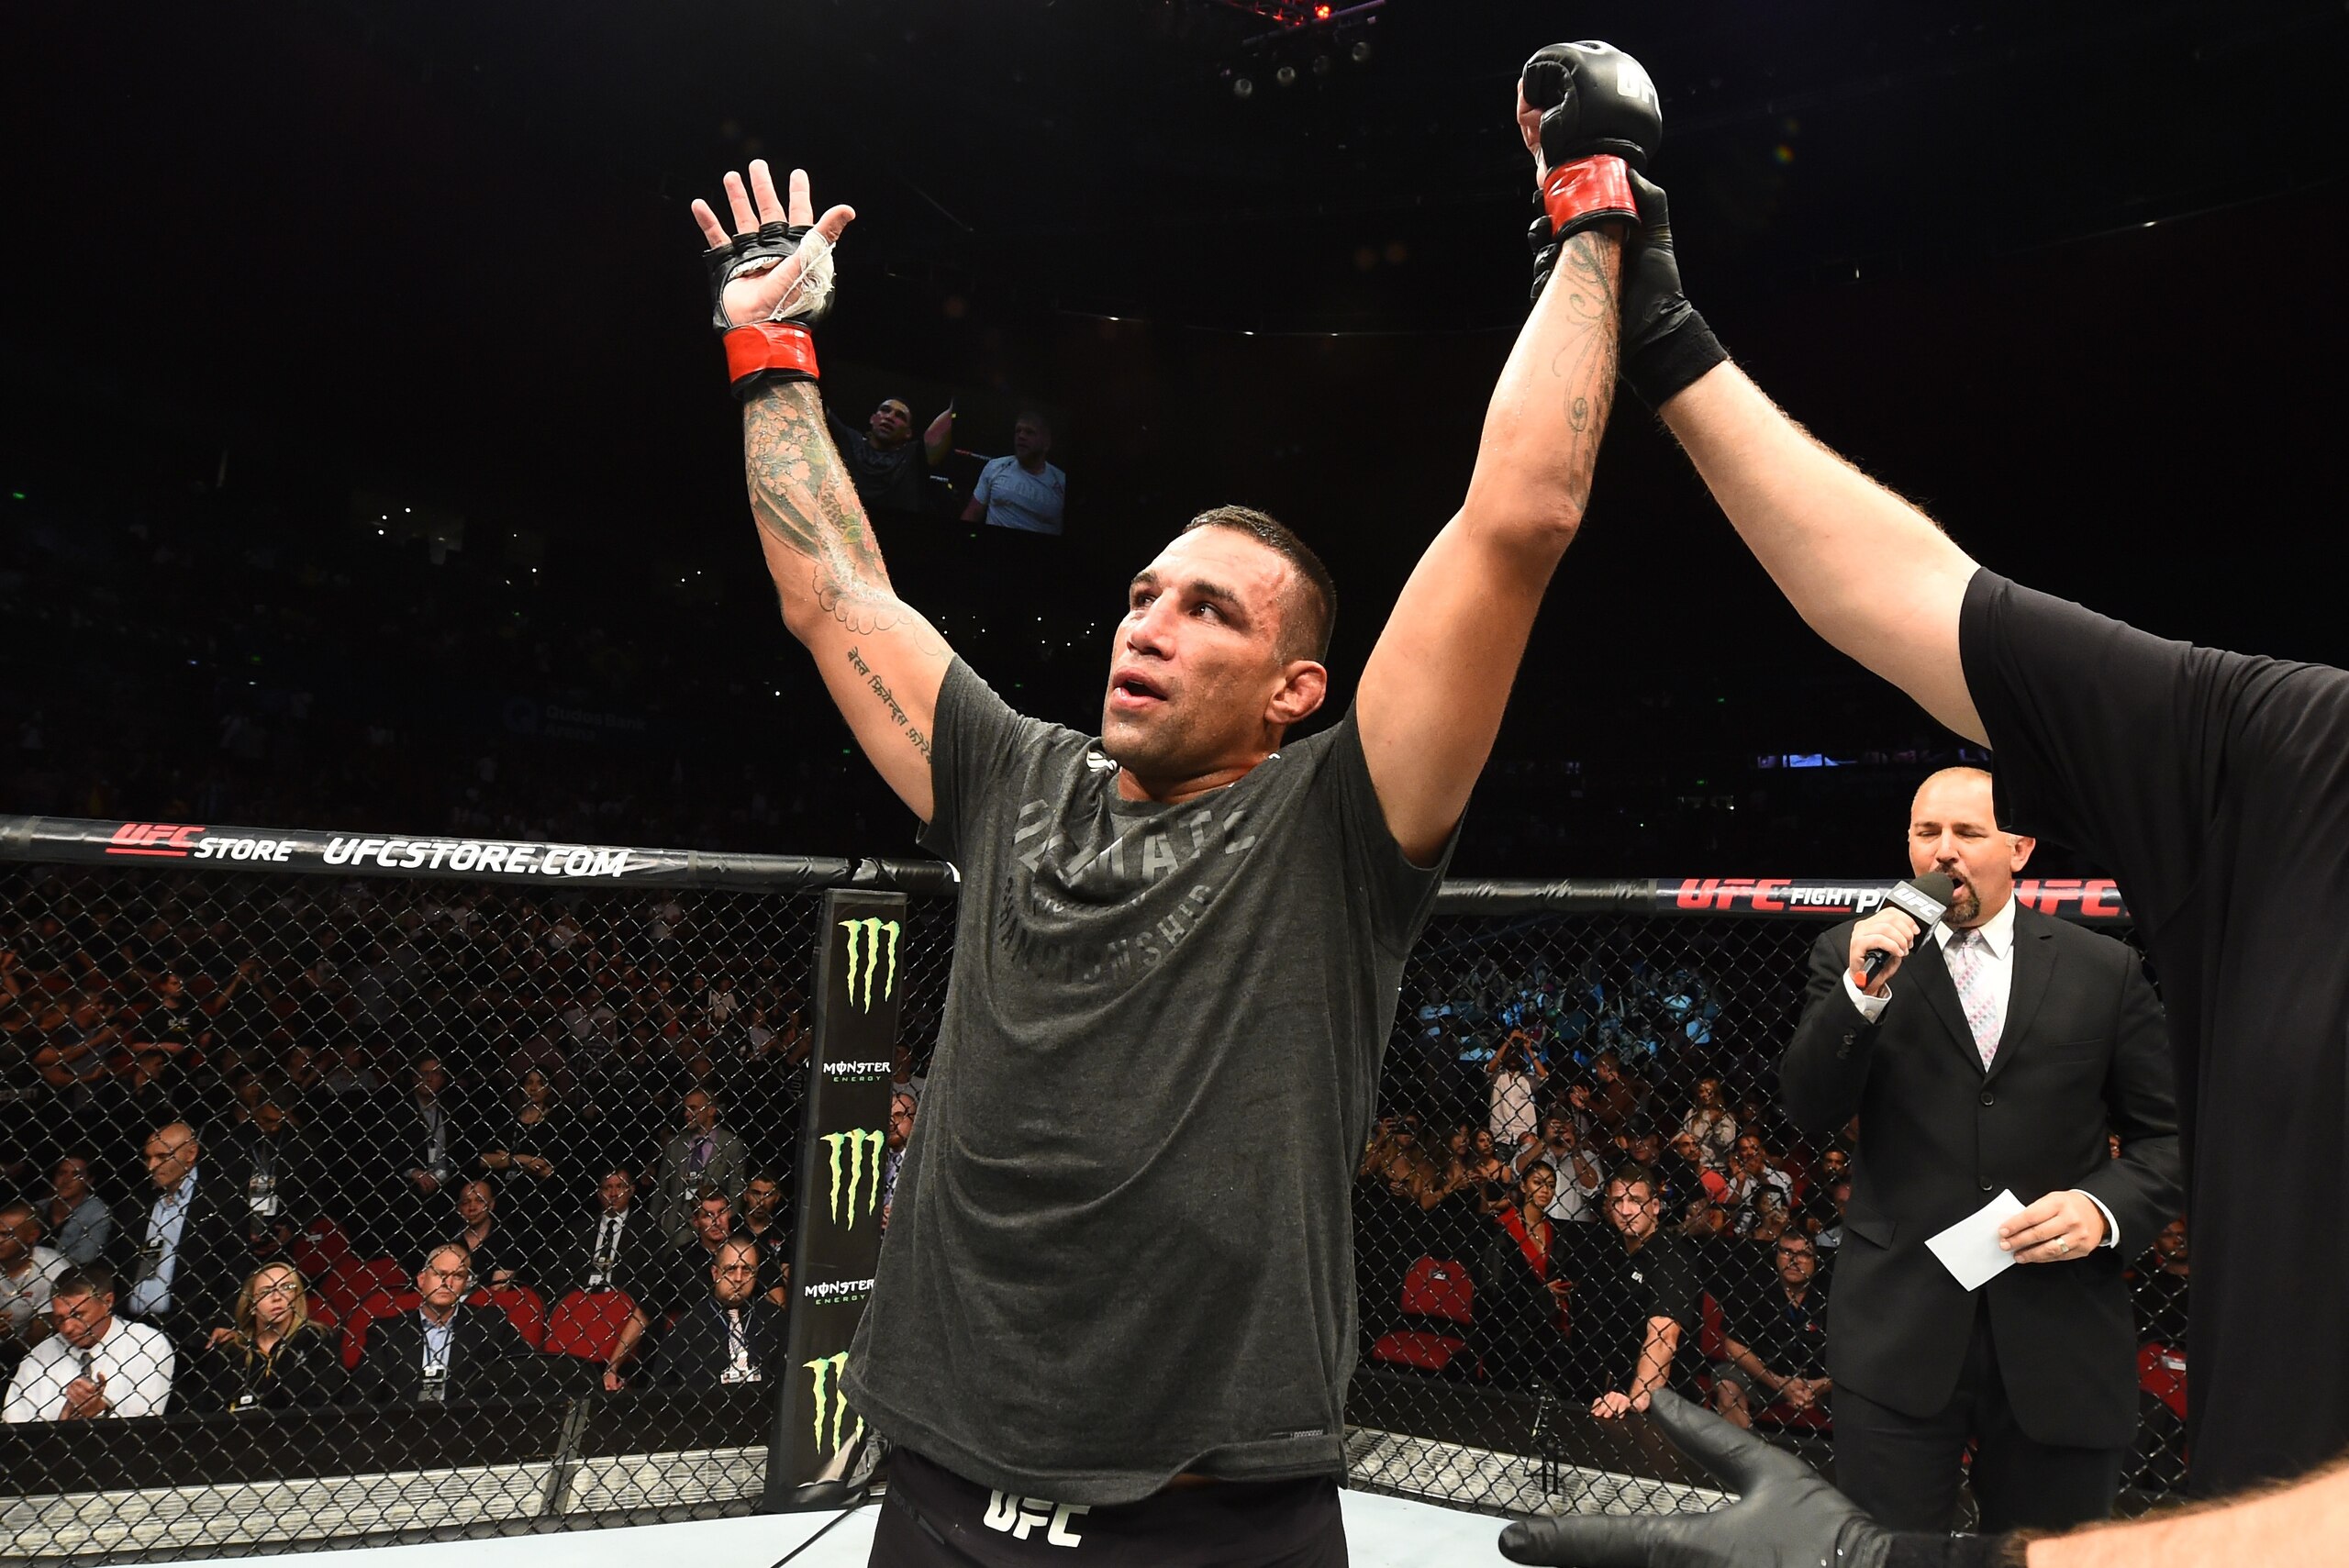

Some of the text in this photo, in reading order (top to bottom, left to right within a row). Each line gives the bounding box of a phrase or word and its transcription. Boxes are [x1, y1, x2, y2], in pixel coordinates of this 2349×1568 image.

[111, 823, 629, 878] UFC STORE UFCSTORE.COM
[1676, 878, 1792, 910] UFC
[1790, 887, 1858, 906] FIGHT
[1893, 887, 1941, 917] UFC
[823, 1061, 892, 1075] MONSTER
[815, 1294, 866, 1306] ENERGY
[983, 1488, 1092, 1549] UFC
